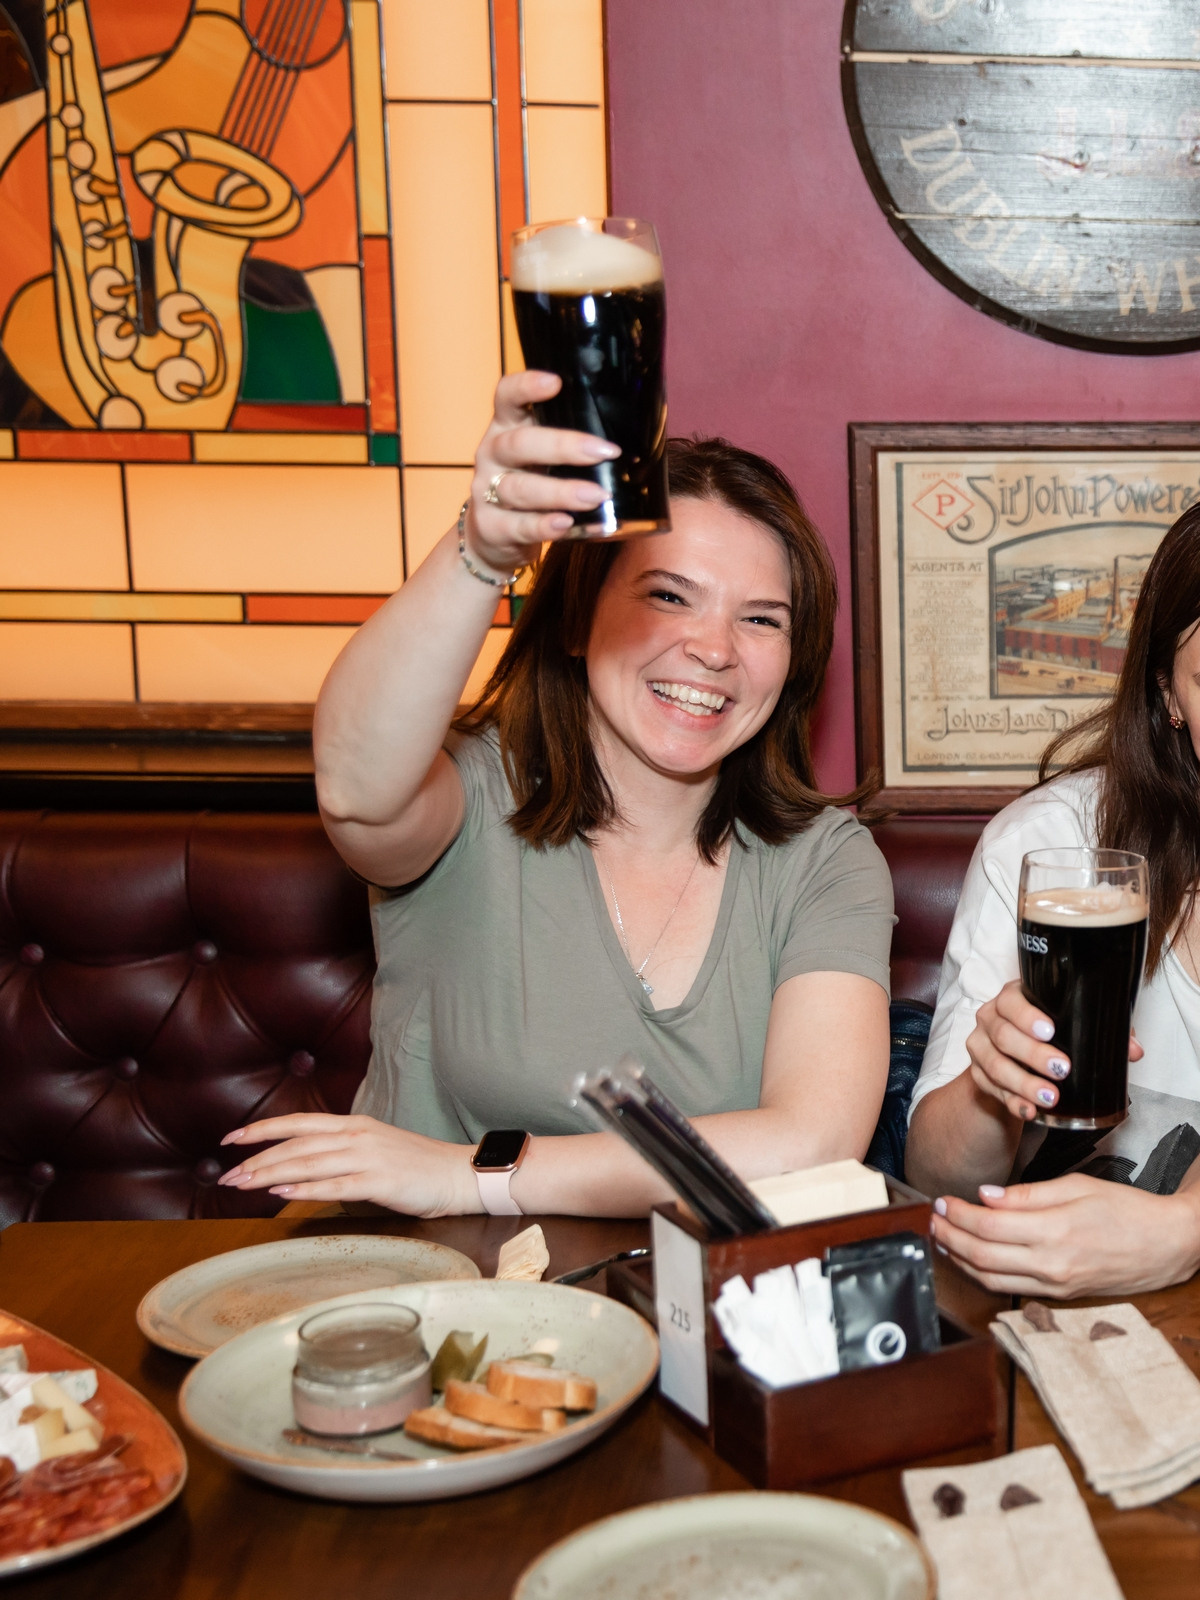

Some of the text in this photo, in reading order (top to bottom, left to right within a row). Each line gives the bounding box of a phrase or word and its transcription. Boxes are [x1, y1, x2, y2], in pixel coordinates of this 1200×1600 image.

[900, 121, 1091, 305] DUBLIN
[935, 494, 956, 517] P
[946, 475, 1023, 544] Sir
[1006, 475, 1090, 526] John
[910, 561, 985, 573] AGENTS AT
[927, 704, 1000, 741] John's
[1001, 705, 1047, 735] Lane
[917, 752, 960, 761] LONDON
[670, 1302, 691, 1332] 215
